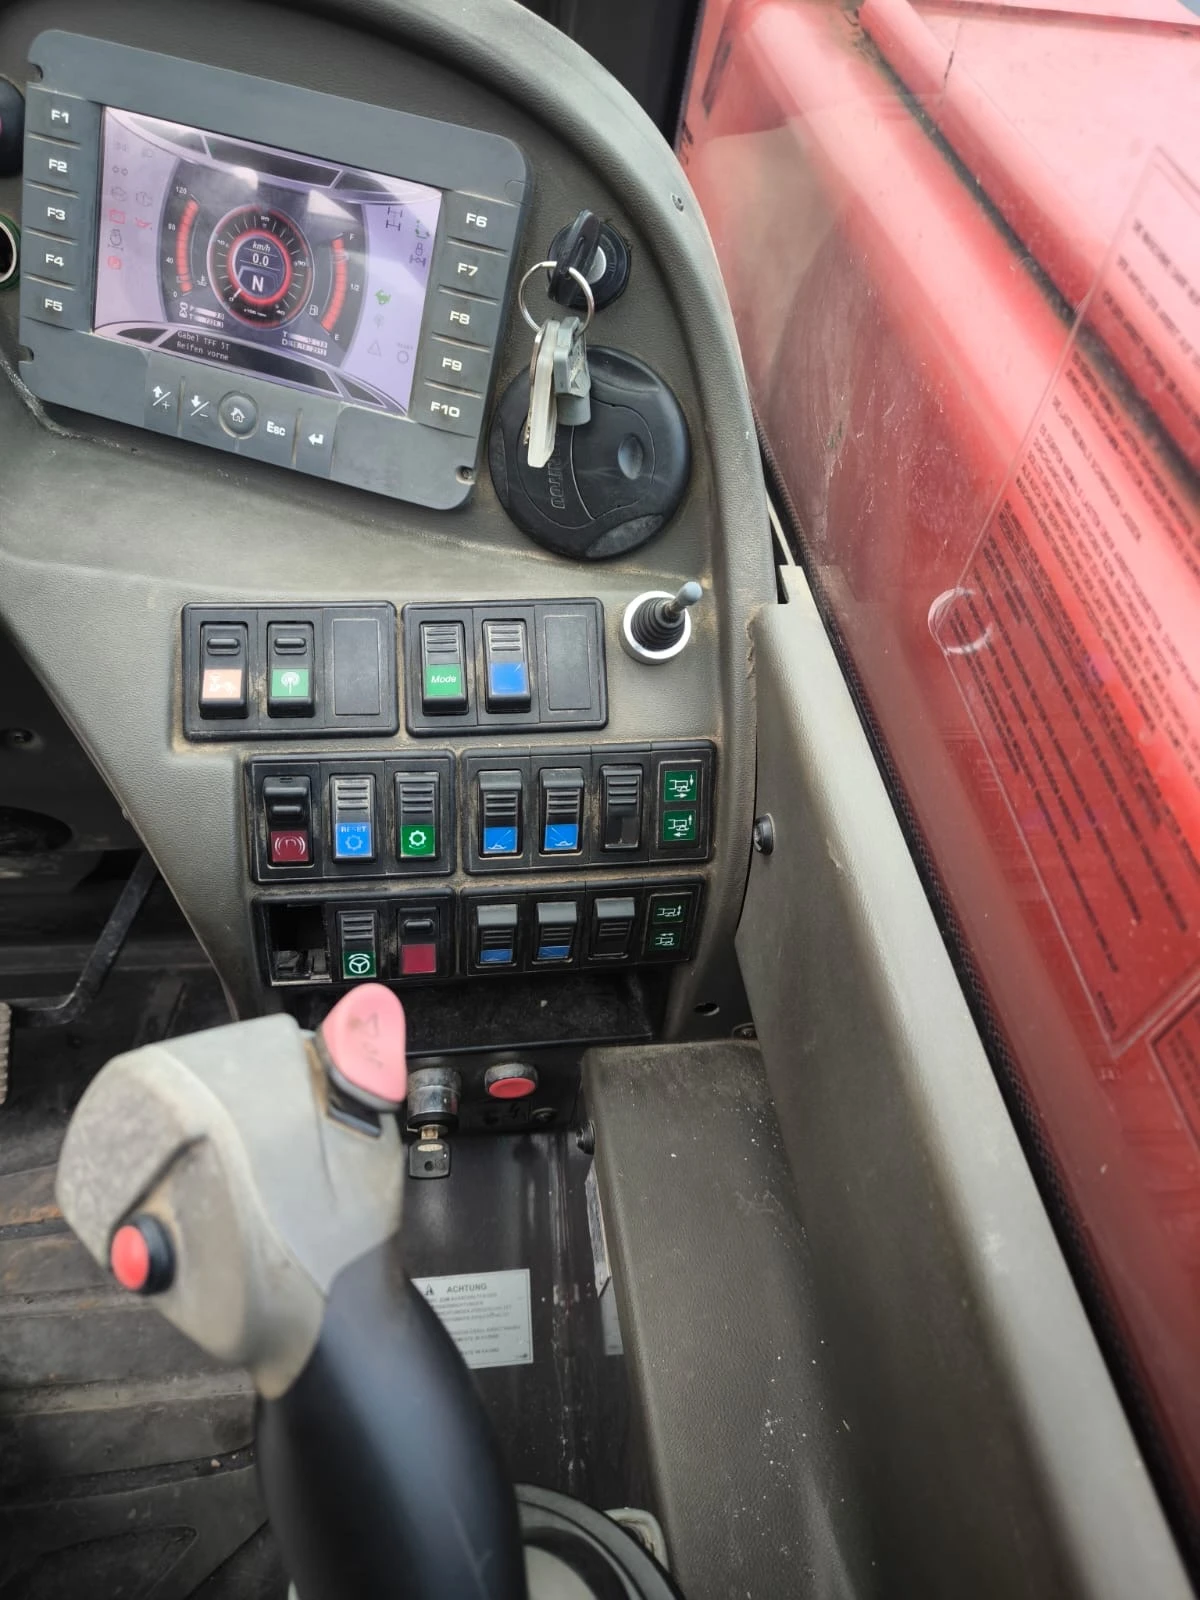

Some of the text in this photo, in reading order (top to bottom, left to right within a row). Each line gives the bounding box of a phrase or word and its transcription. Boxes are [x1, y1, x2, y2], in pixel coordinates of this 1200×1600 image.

[51, 109, 70, 124] F1
[48, 158, 68, 173] F2
[47, 207, 66, 221] F3
[465, 213, 488, 228] F6
[252, 241, 271, 252] km/h
[45, 253, 65, 267] F4
[252, 253, 270, 266] 0.0
[457, 262, 479, 277] F7
[252, 275, 264, 292] N
[44, 298, 63, 312] F5
[449, 311, 470, 326] F8
[177, 331, 199, 342] Gabel
[442, 357, 462, 372] F9
[430, 402, 460, 418] F10
[266, 421, 286, 437] Esc
[430, 674, 457, 684] Mode
[340, 825, 368, 833] RESET
[446, 1282, 488, 1294] ACHTUNG
